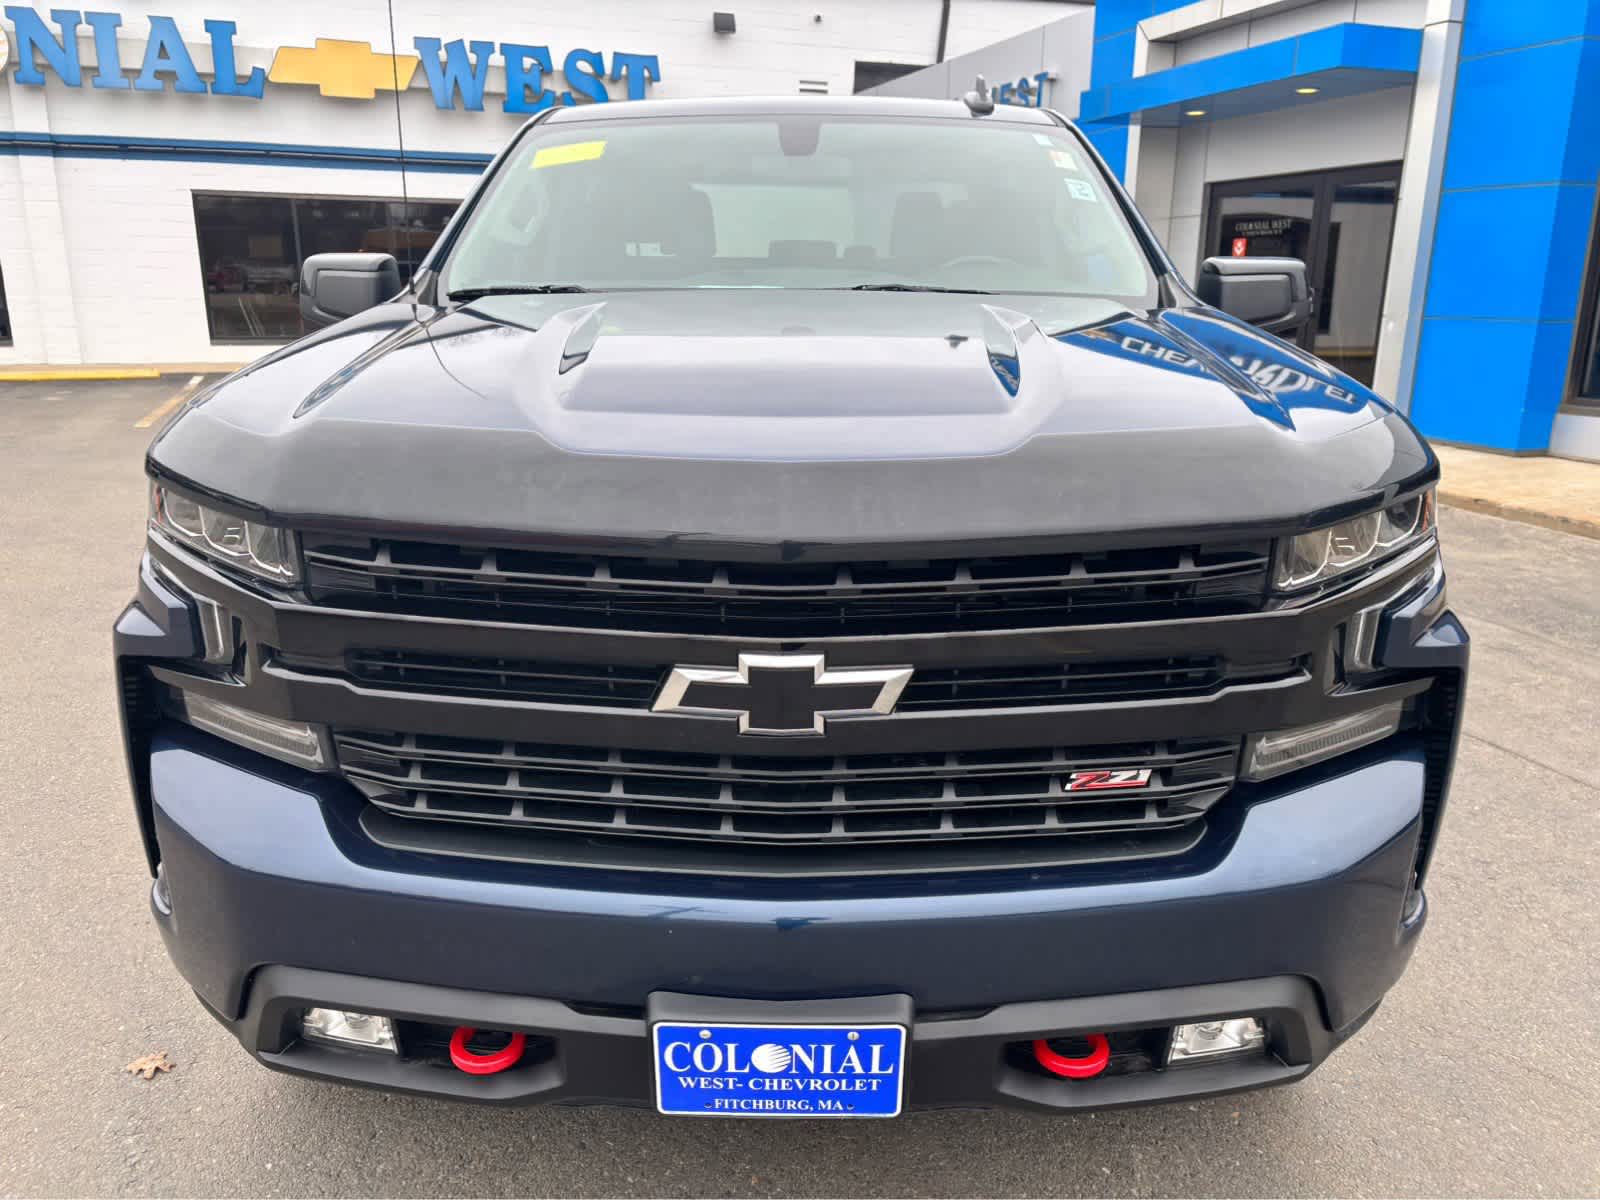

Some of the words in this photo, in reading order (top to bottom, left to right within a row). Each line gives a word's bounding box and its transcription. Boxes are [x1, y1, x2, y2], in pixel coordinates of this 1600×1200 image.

[0, 6, 265, 99] NIAL
[414, 36, 660, 113] WEST
[991, 71, 1050, 107] EST
[1064, 768, 1153, 791] Z71
[663, 1041, 893, 1075] COLONIAL
[748, 1077, 882, 1091] CHEVROLET
[714, 1098, 814, 1111] FITCHBURG,
[817, 1099, 844, 1111] MA
